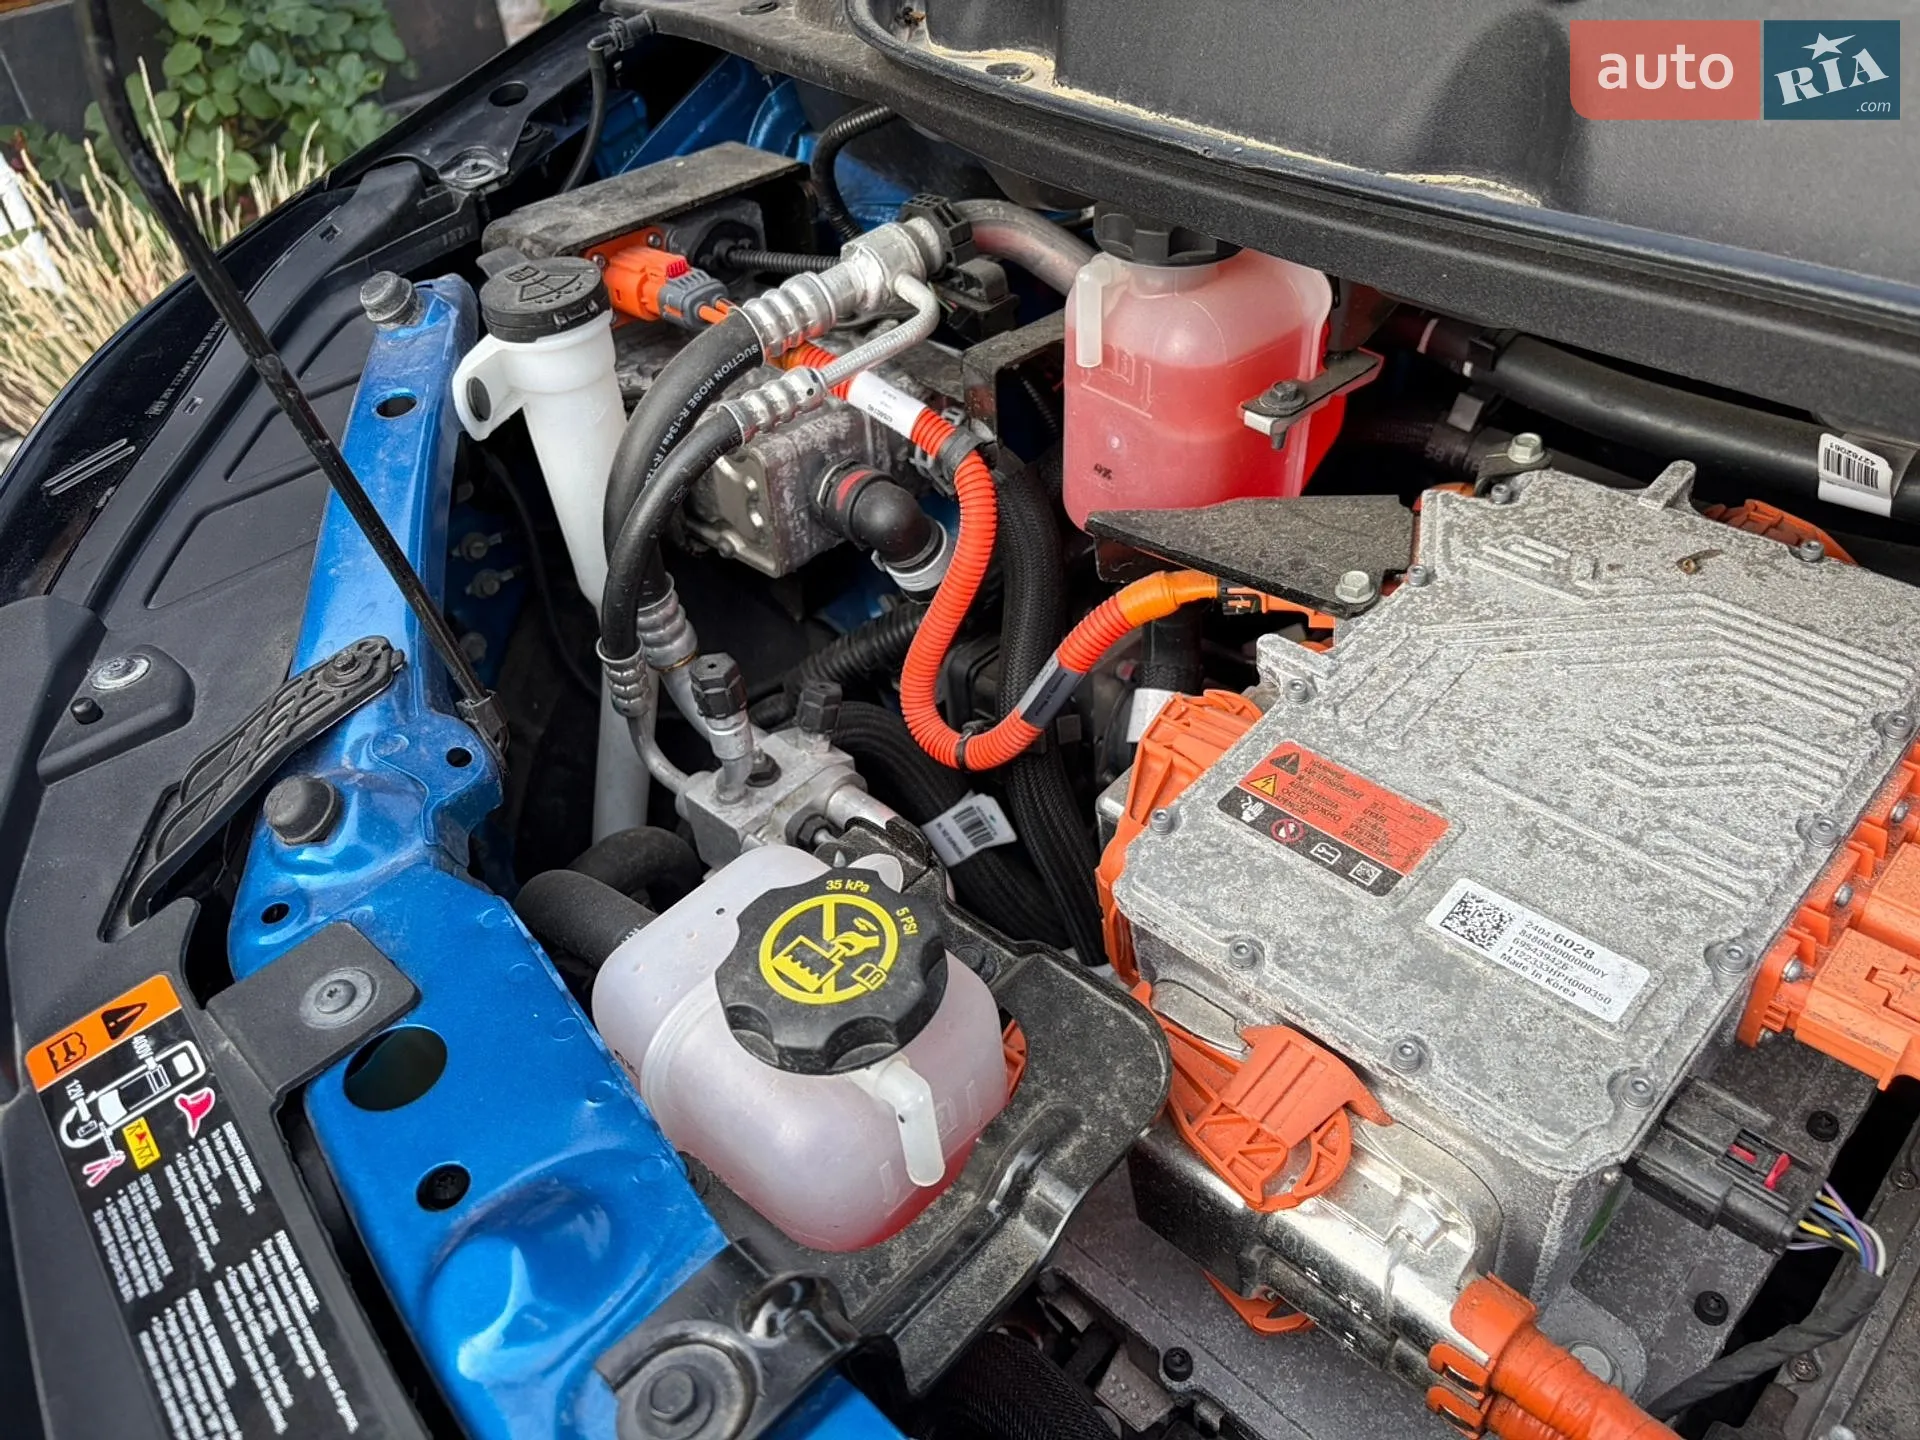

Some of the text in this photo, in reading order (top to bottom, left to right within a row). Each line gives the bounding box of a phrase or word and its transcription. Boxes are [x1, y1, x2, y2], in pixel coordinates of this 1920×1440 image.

[713, 343, 759, 380] SUCTION
[686, 377, 717, 408] HOSE
[661, 407, 690, 446] R-134a
[1280, 786, 1343, 822] ОСТОРОЖНО
[826, 879, 870, 893] 35 kPa
[896, 906, 918, 935] 5 PSI
[1524, 919, 1595, 961] 2404 6028
[1499, 951, 1529, 972] Made
[1544, 976, 1577, 998] Korea
[129, 1032, 154, 1061] 400V
[62, 1078, 85, 1102] 12V
